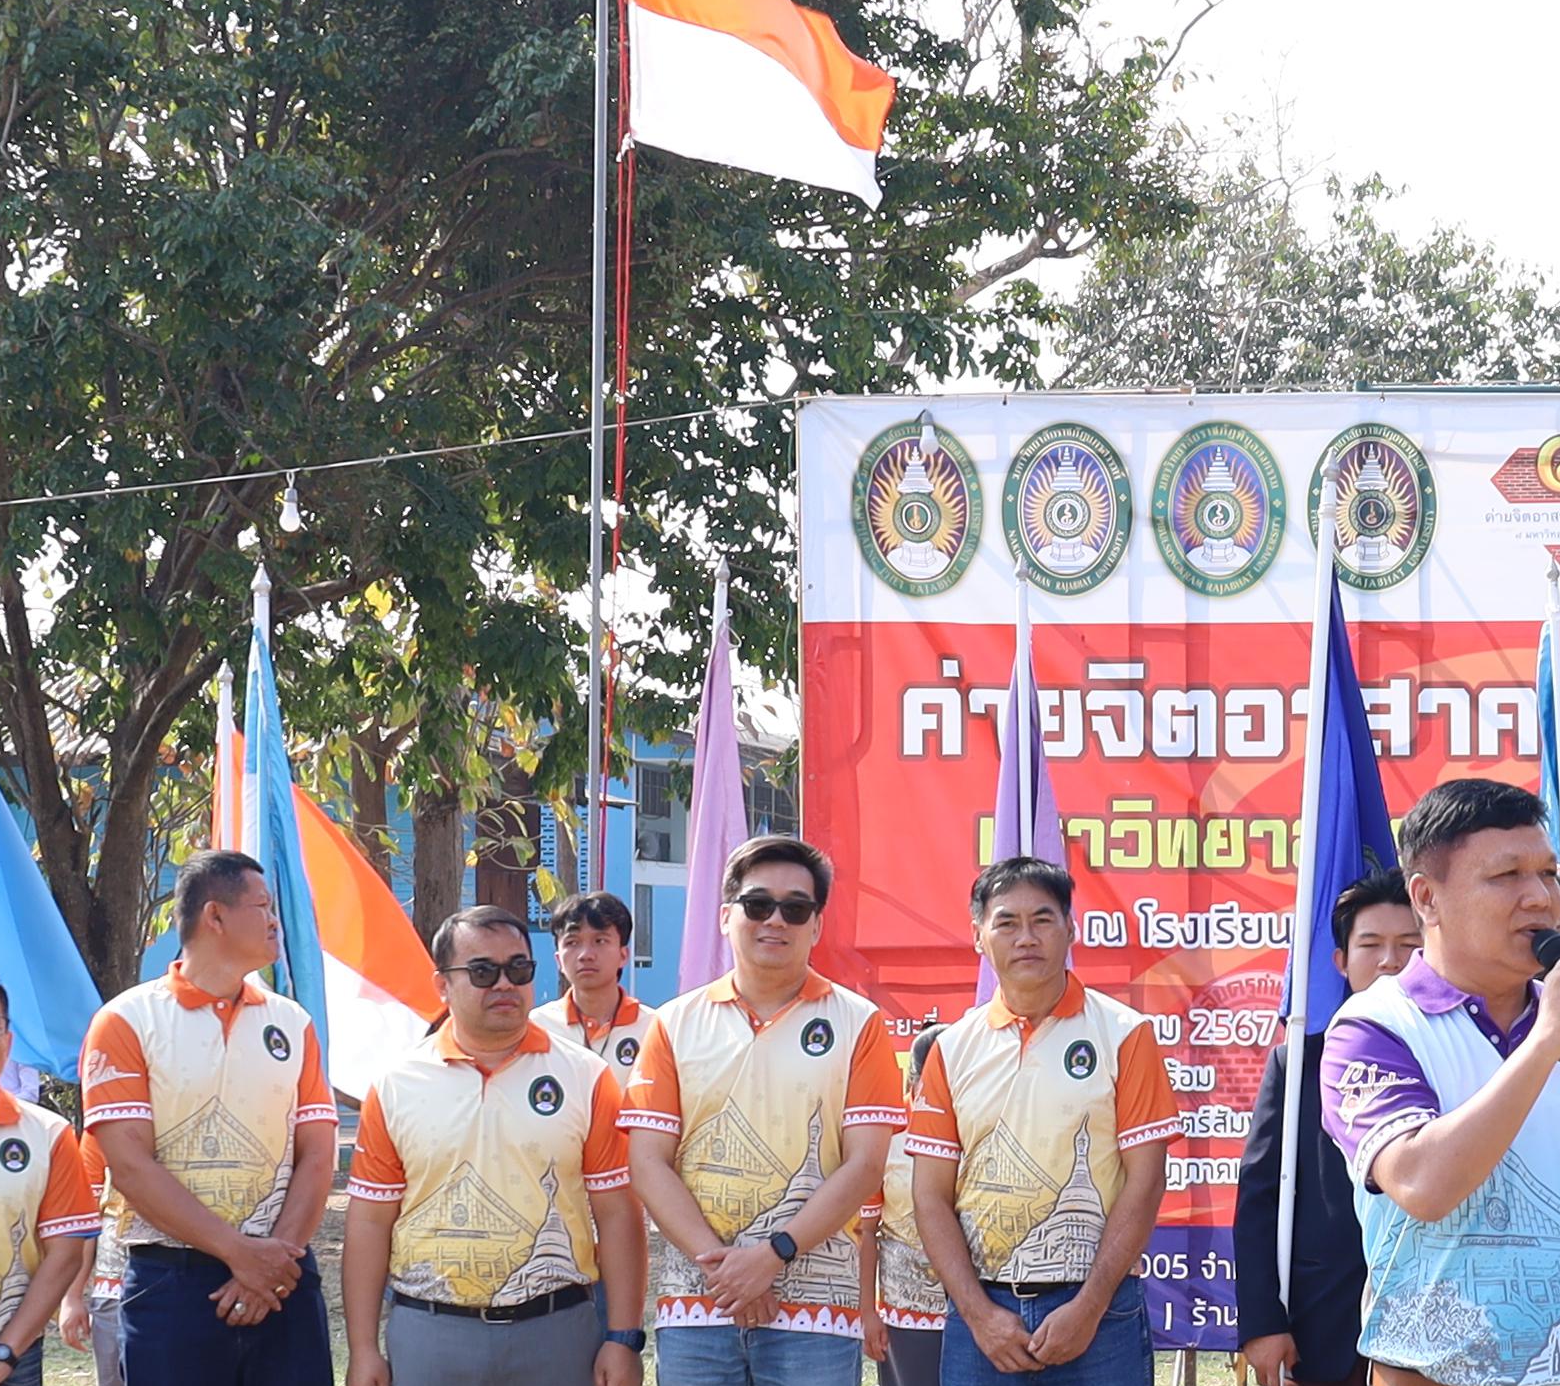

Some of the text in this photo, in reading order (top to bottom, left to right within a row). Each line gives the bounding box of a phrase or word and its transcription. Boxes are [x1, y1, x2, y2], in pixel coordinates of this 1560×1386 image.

[1348, 569, 1405, 589] RAJABHAT
[1086, 914, 1123, 945] ณ
[1191, 1010, 1277, 1044] 2567
